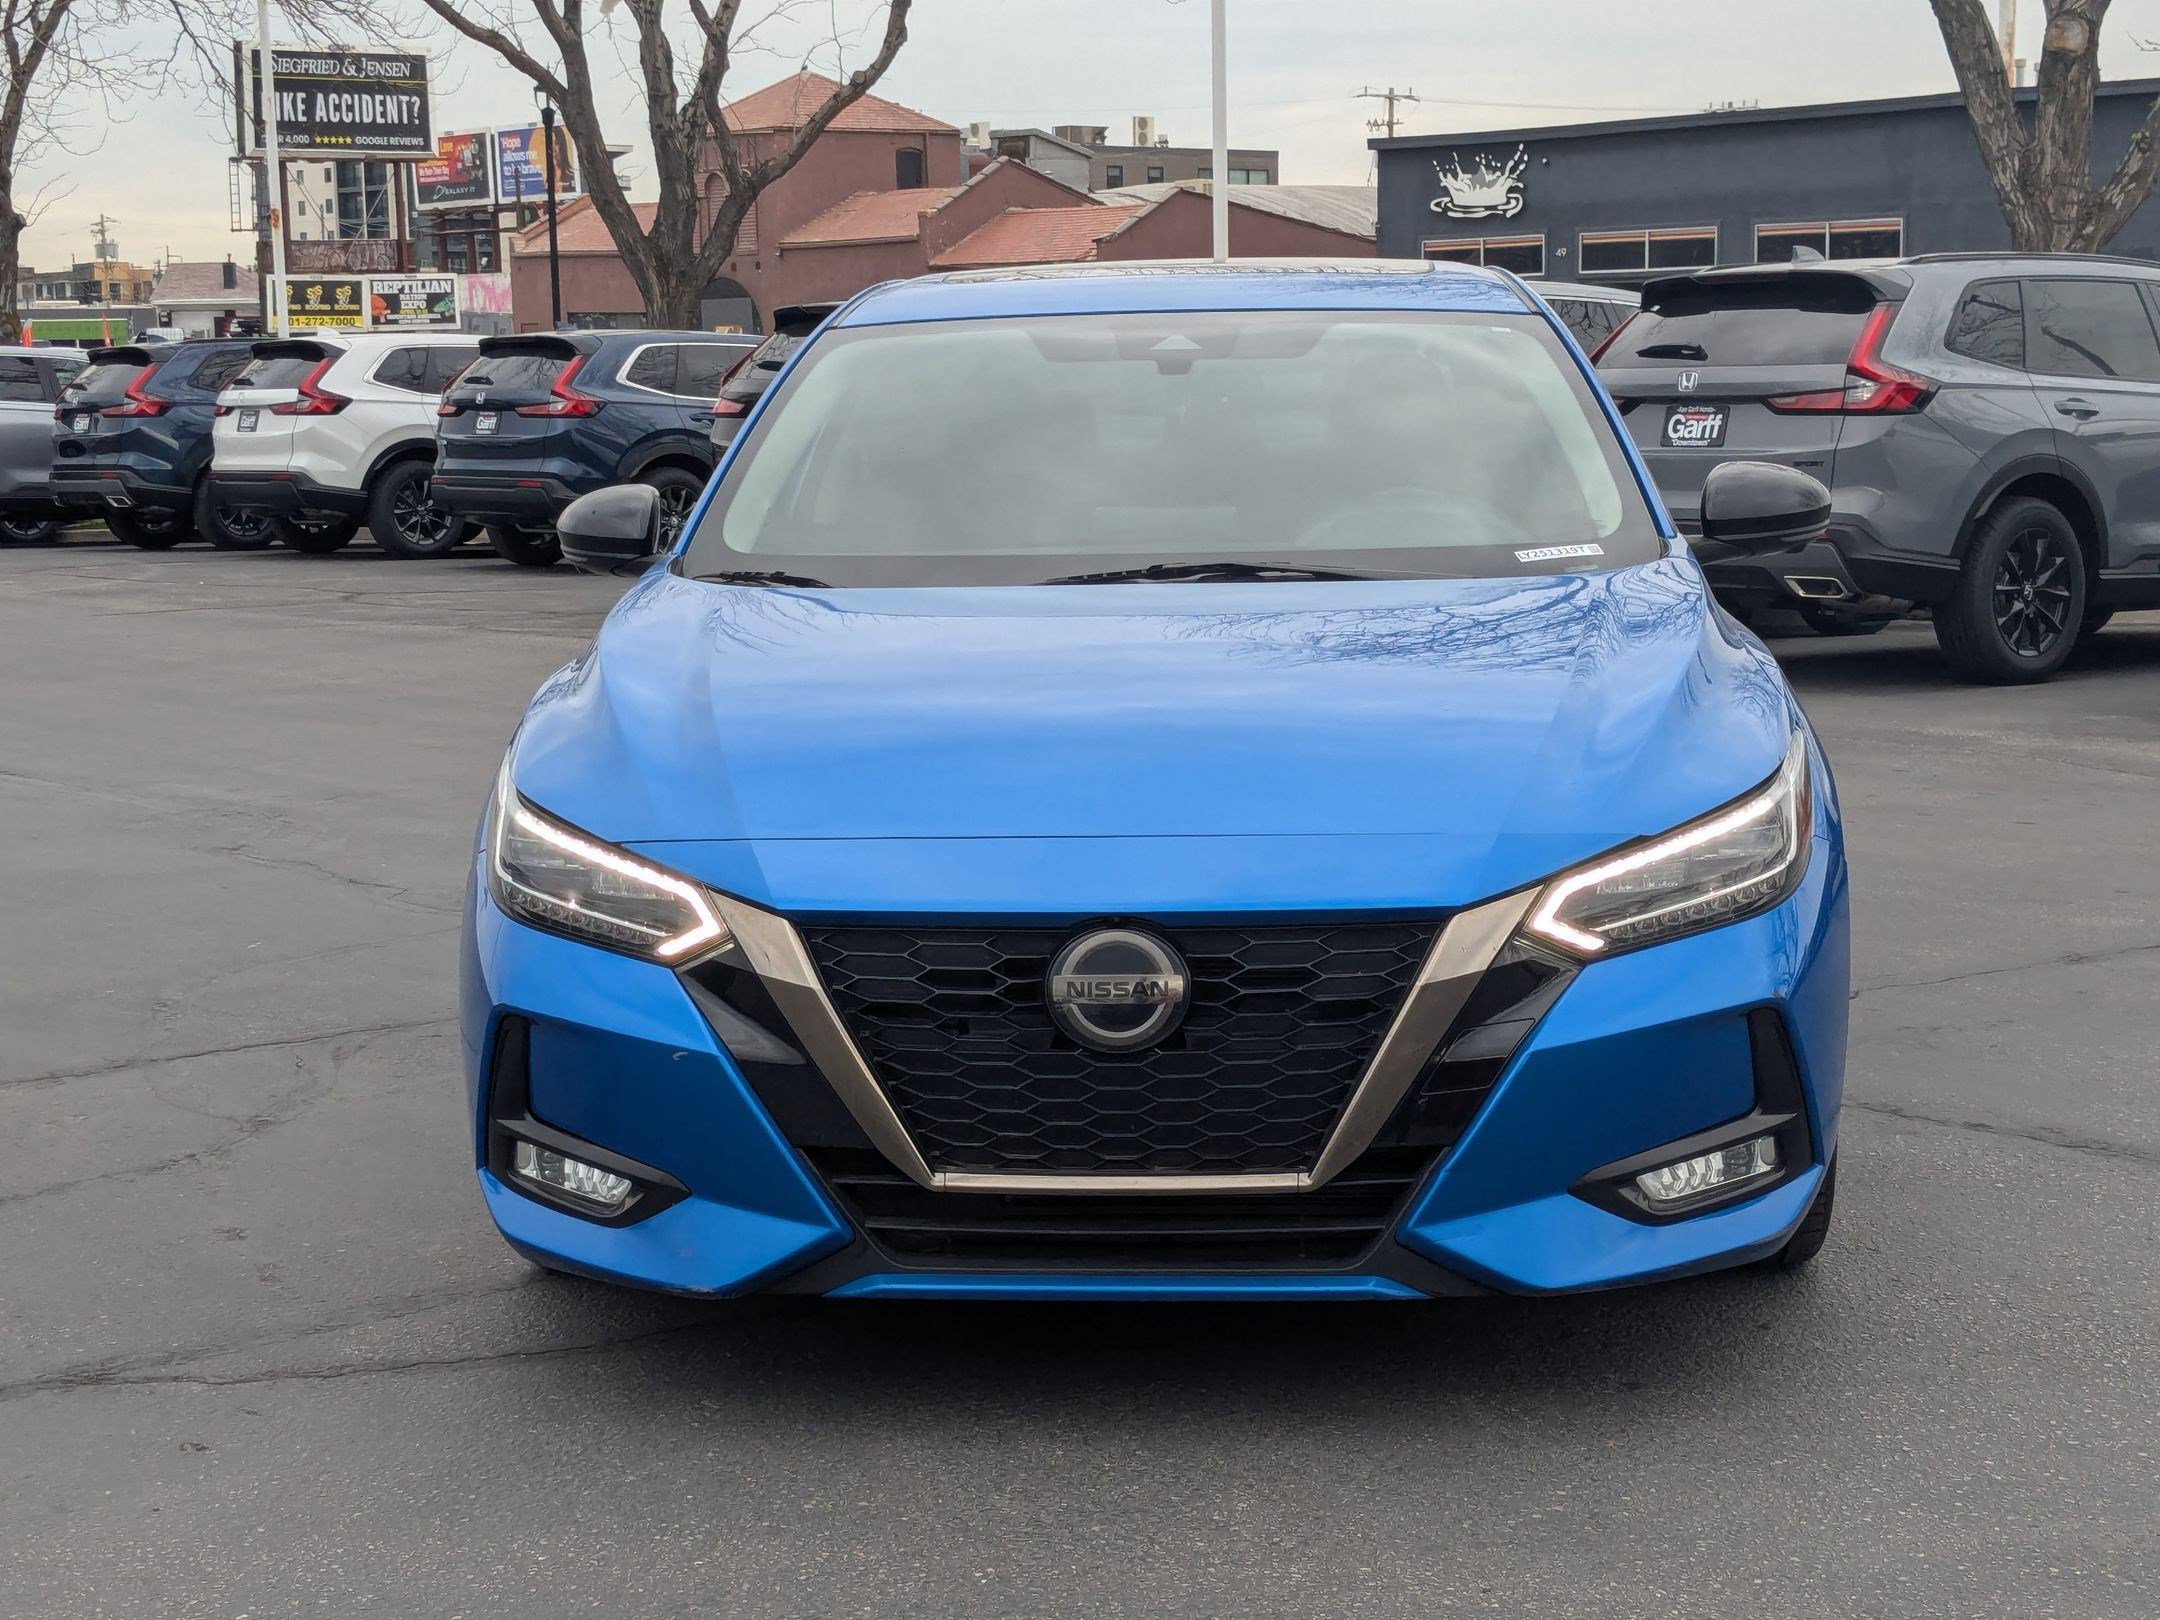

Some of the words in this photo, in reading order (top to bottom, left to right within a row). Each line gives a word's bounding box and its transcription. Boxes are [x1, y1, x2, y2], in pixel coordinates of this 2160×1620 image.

[271, 54, 340, 75] SIEGFRIED
[342, 58, 358, 77] &
[359, 57, 411, 78] JENSEN
[262, 91, 308, 123] IKE
[315, 92, 421, 125] ACCIDENT?
[285, 134, 310, 145] 4,000
[355, 136, 389, 145] GOOGLE
[389, 137, 424, 146] REVIEWS
[1555, 247, 1567, 257] 49
[372, 280, 452, 294] REPTILIAN
[400, 300, 427, 309] EXPO
[288, 317, 356, 326] 01-272-7000
[1667, 413, 1723, 439] Garff
[1066, 980, 1169, 998] NISSAN
